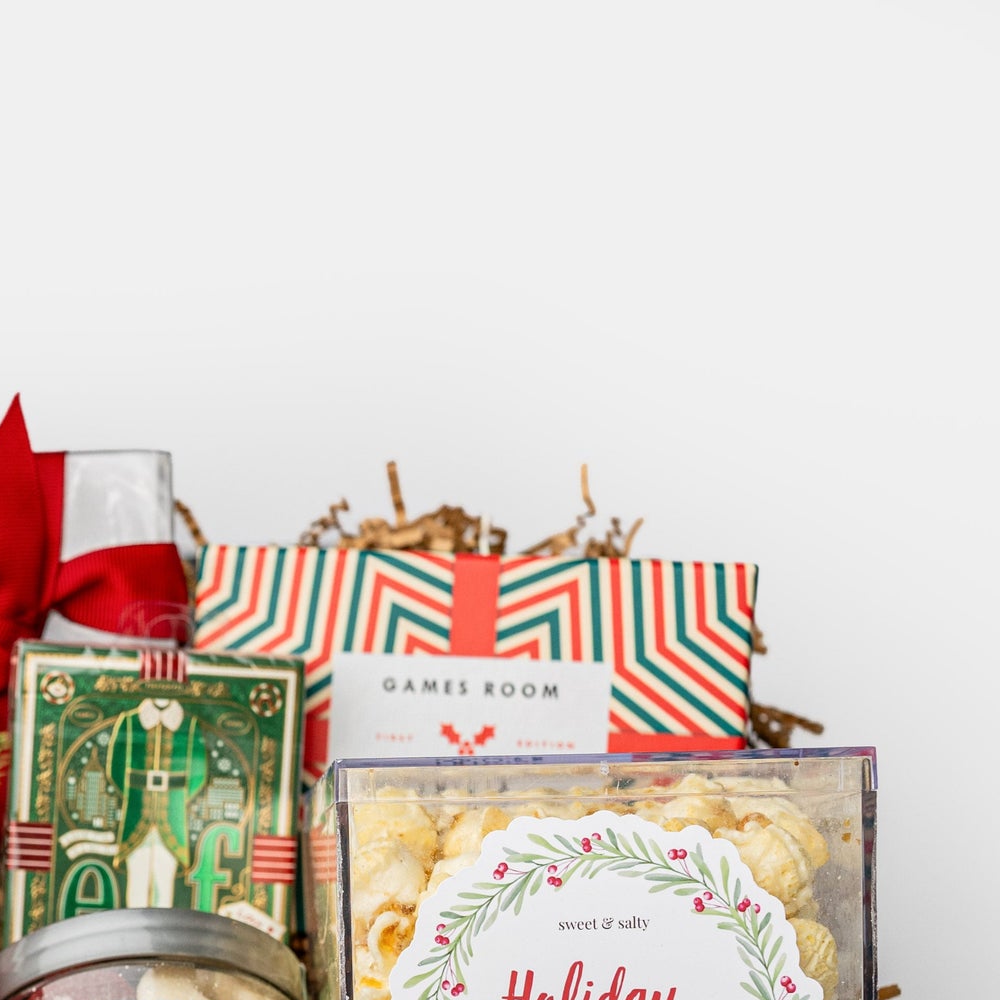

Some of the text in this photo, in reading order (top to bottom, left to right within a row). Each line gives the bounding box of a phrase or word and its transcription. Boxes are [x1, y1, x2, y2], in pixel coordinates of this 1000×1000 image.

[383, 677, 560, 699] GAMES ROOM
[558, 915, 650, 931] sweet & salty
